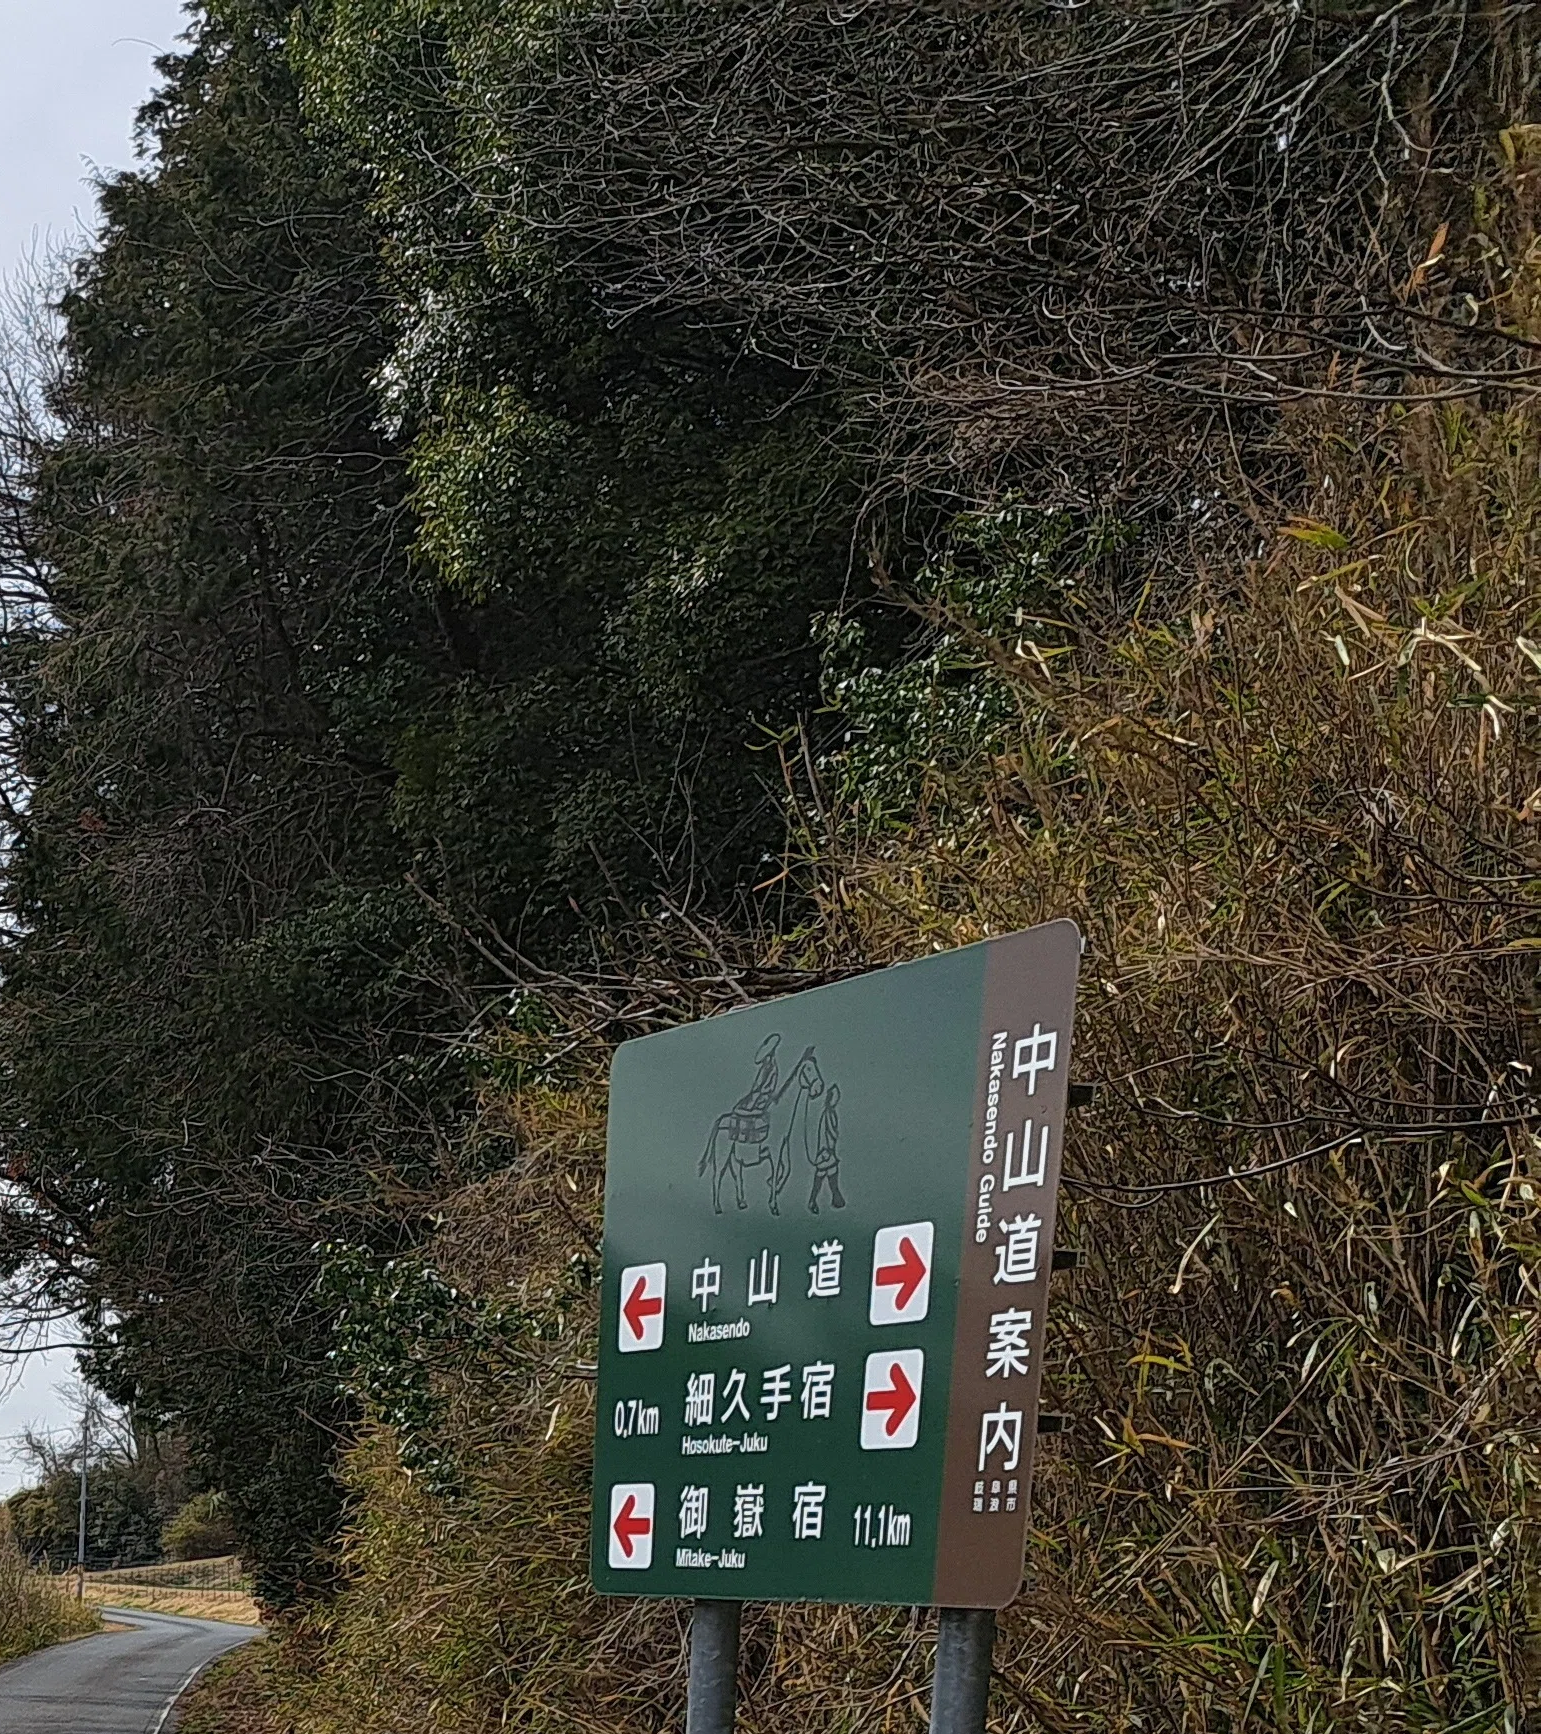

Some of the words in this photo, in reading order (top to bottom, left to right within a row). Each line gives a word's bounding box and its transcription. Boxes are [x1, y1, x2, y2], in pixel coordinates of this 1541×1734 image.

[981, 1031, 1008, 1165] Nakasendo
[974, 1173, 996, 1244] Guide
[691, 1239, 844, 1313] 中山道
[977, 1022, 1058, 1472] 中山道案内
[687, 1317, 750, 1343] Nakasendo
[683, 1360, 835, 1427] 細久手宿
[681, 1433, 768, 1455] Hosokute-Juku
[678, 1481, 826, 1540] 御嶽宿
[853, 1504, 912, 1548] 11.1km
[675, 1547, 745, 1569] Mitake-Juku
